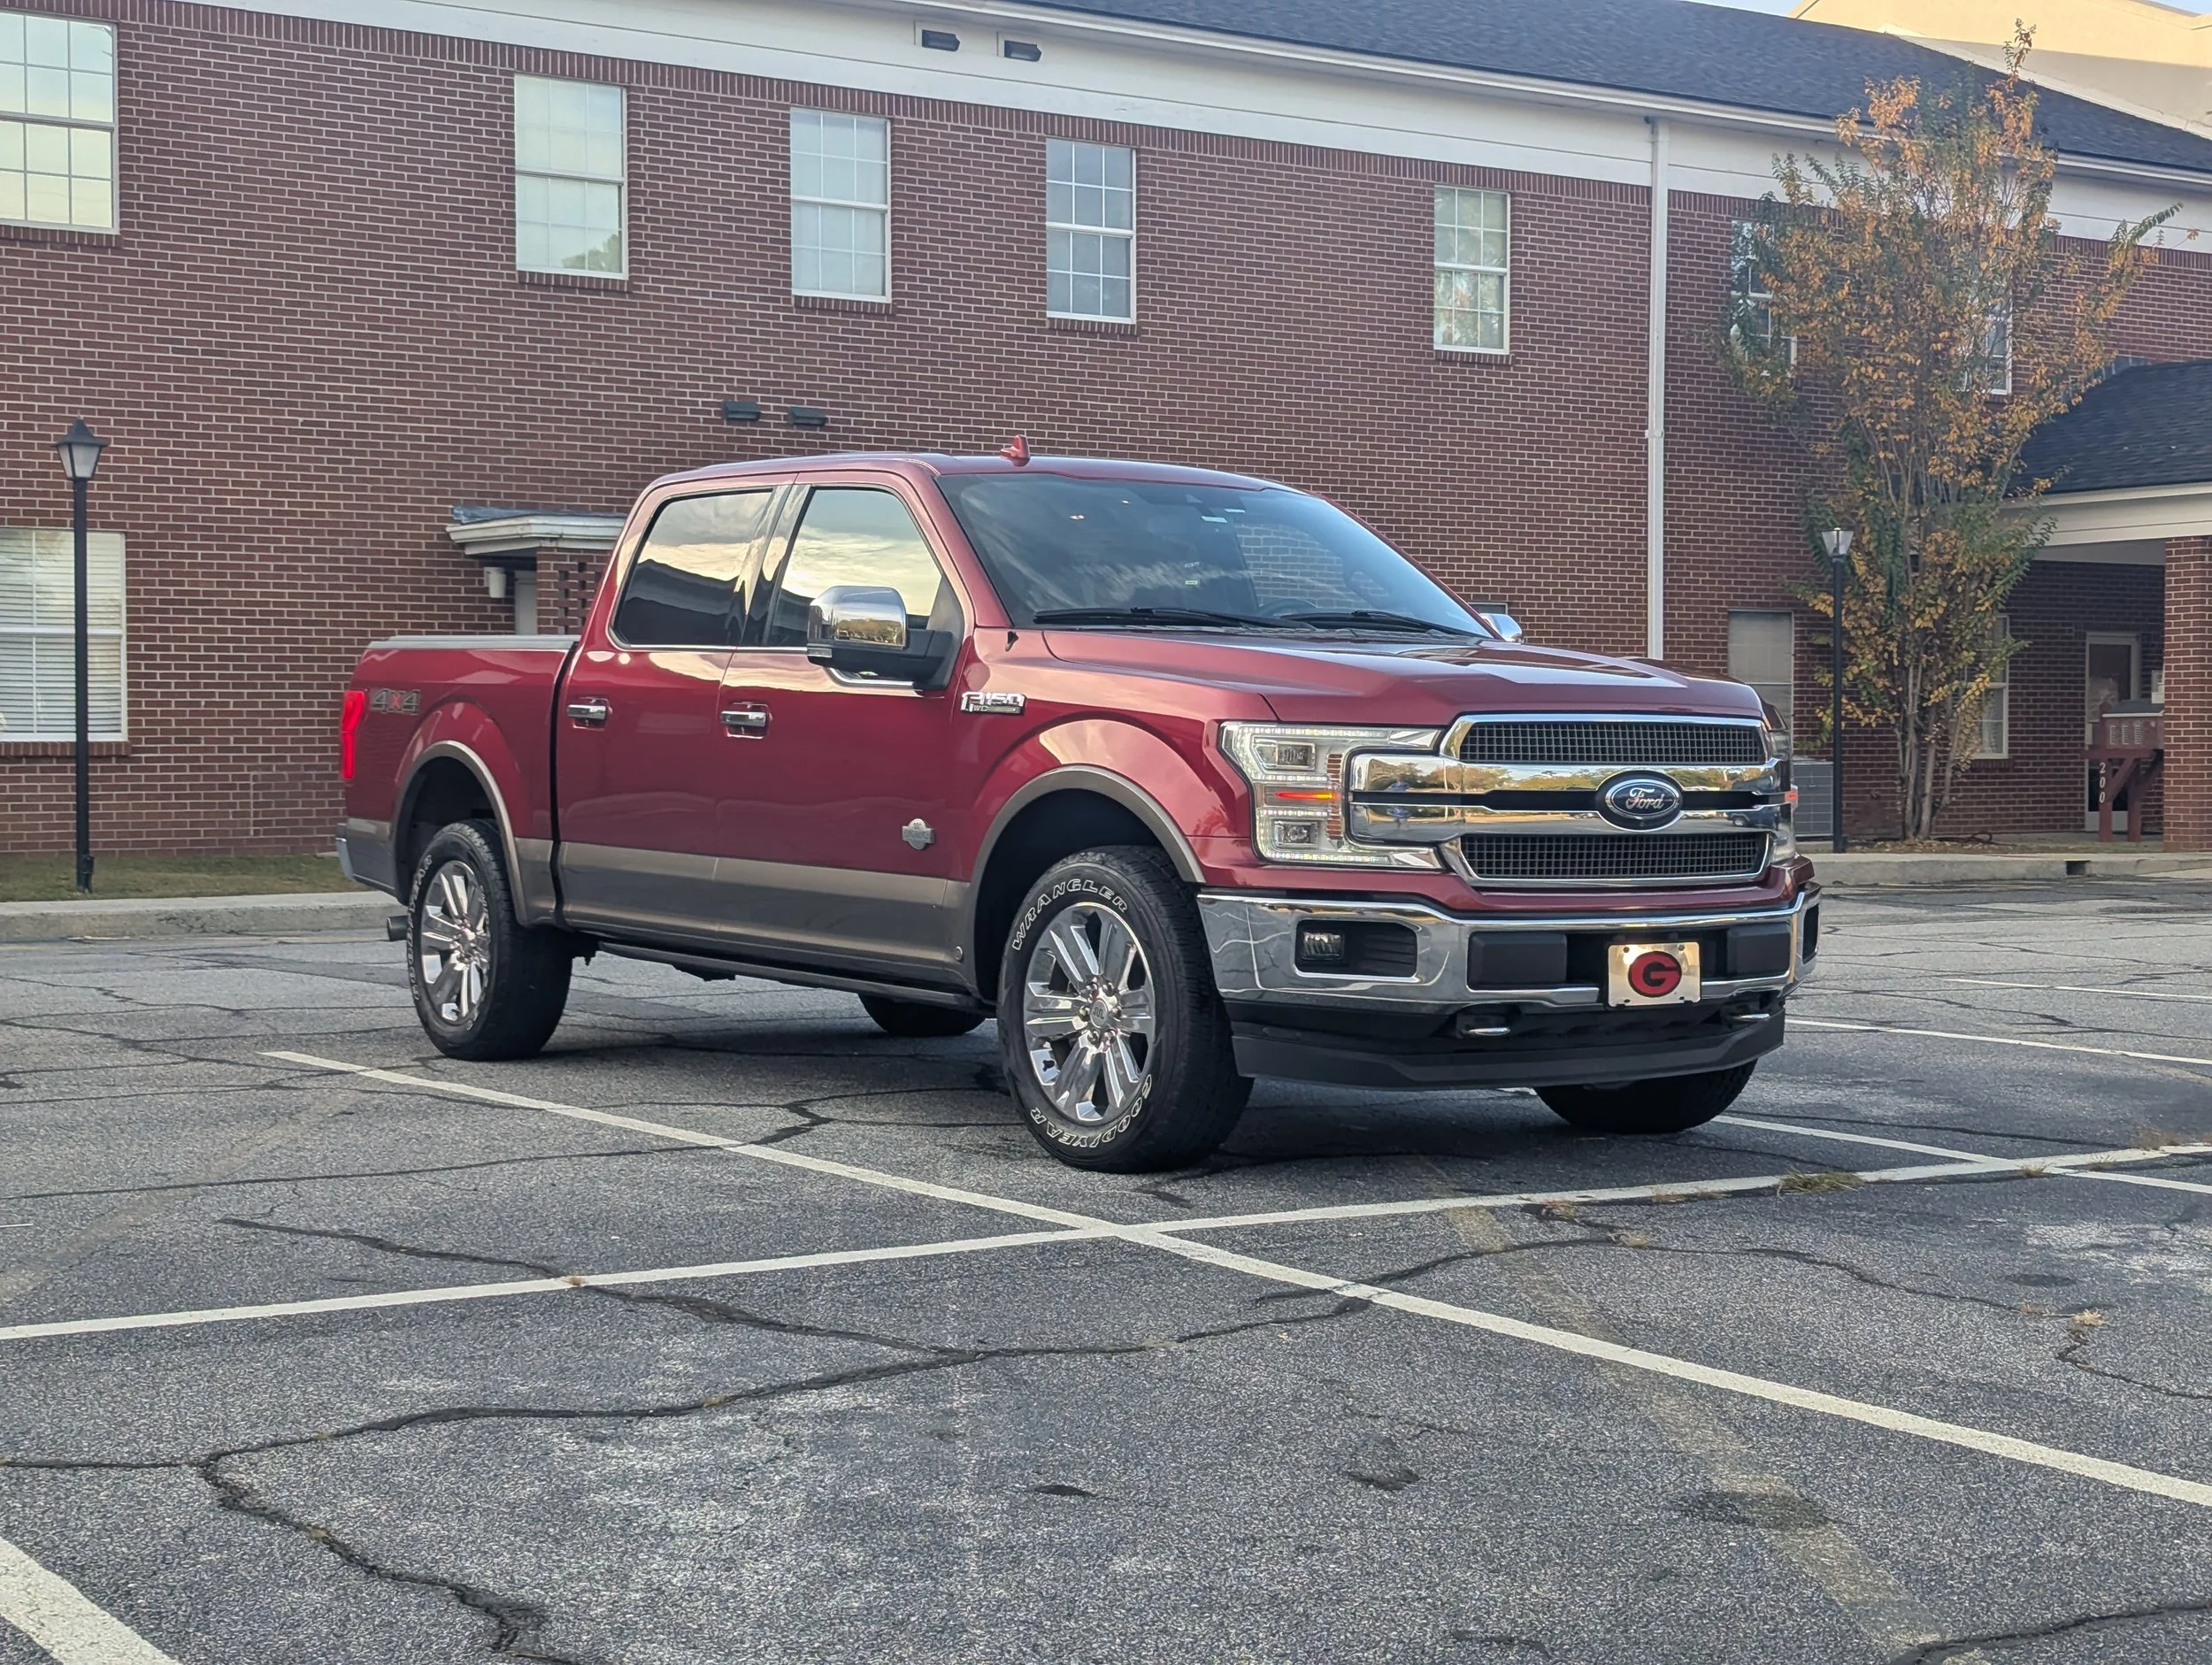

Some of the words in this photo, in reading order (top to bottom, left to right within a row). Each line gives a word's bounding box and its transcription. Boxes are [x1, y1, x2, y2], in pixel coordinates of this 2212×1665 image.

[1625, 787, 1664, 809] Ford
[1011, 879, 1128, 951] WRANGLER
[1628, 950, 1682, 998] G
[1030, 1073, 1152, 1148] GOODYEAR
